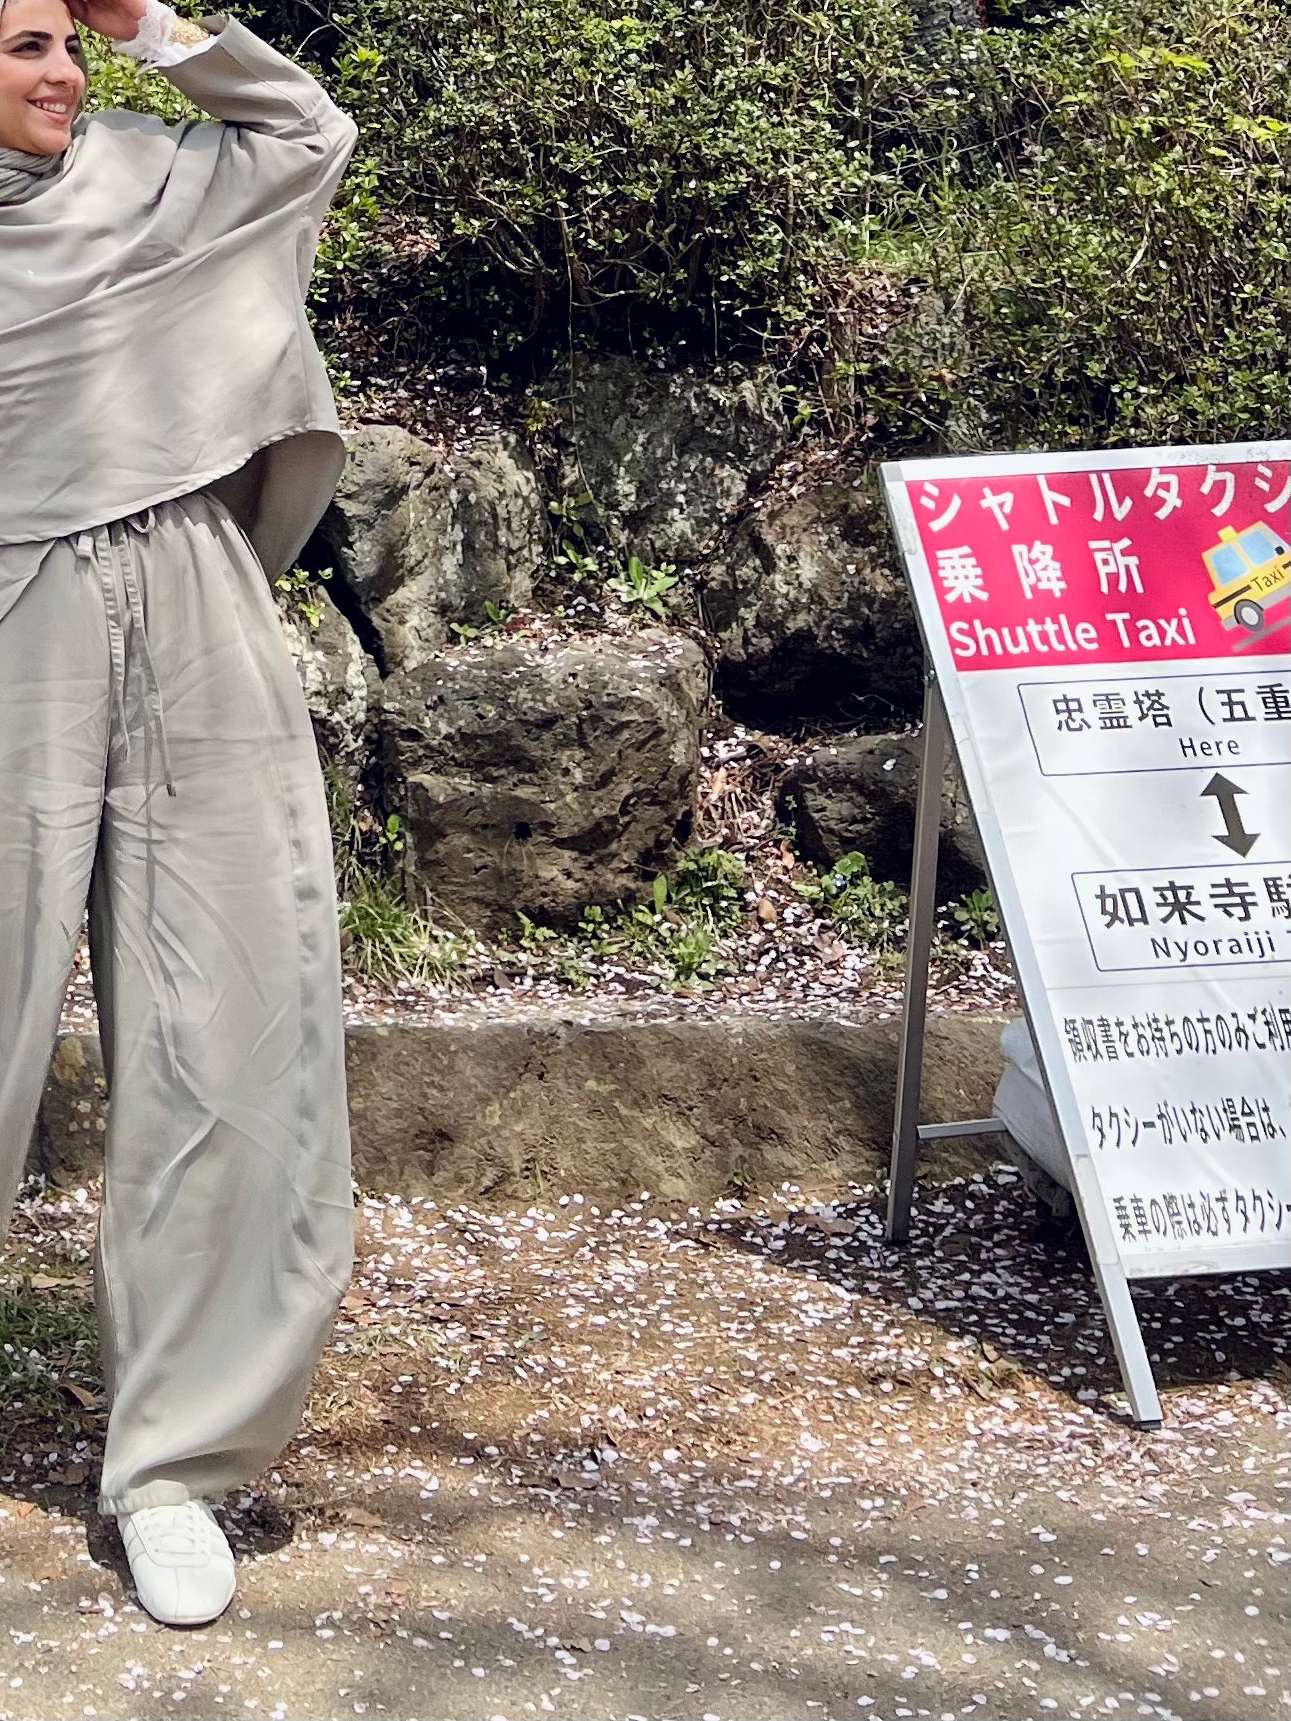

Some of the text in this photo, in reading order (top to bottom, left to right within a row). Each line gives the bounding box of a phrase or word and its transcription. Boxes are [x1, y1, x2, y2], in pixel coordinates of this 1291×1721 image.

[936, 537, 1145, 603] 乗降所
[1250, 564, 1285, 592] Taxi
[949, 608, 1196, 658] Shuttle Taxi
[1178, 736, 1241, 758] Here
[1150, 930, 1276, 962] Nyoraiji
